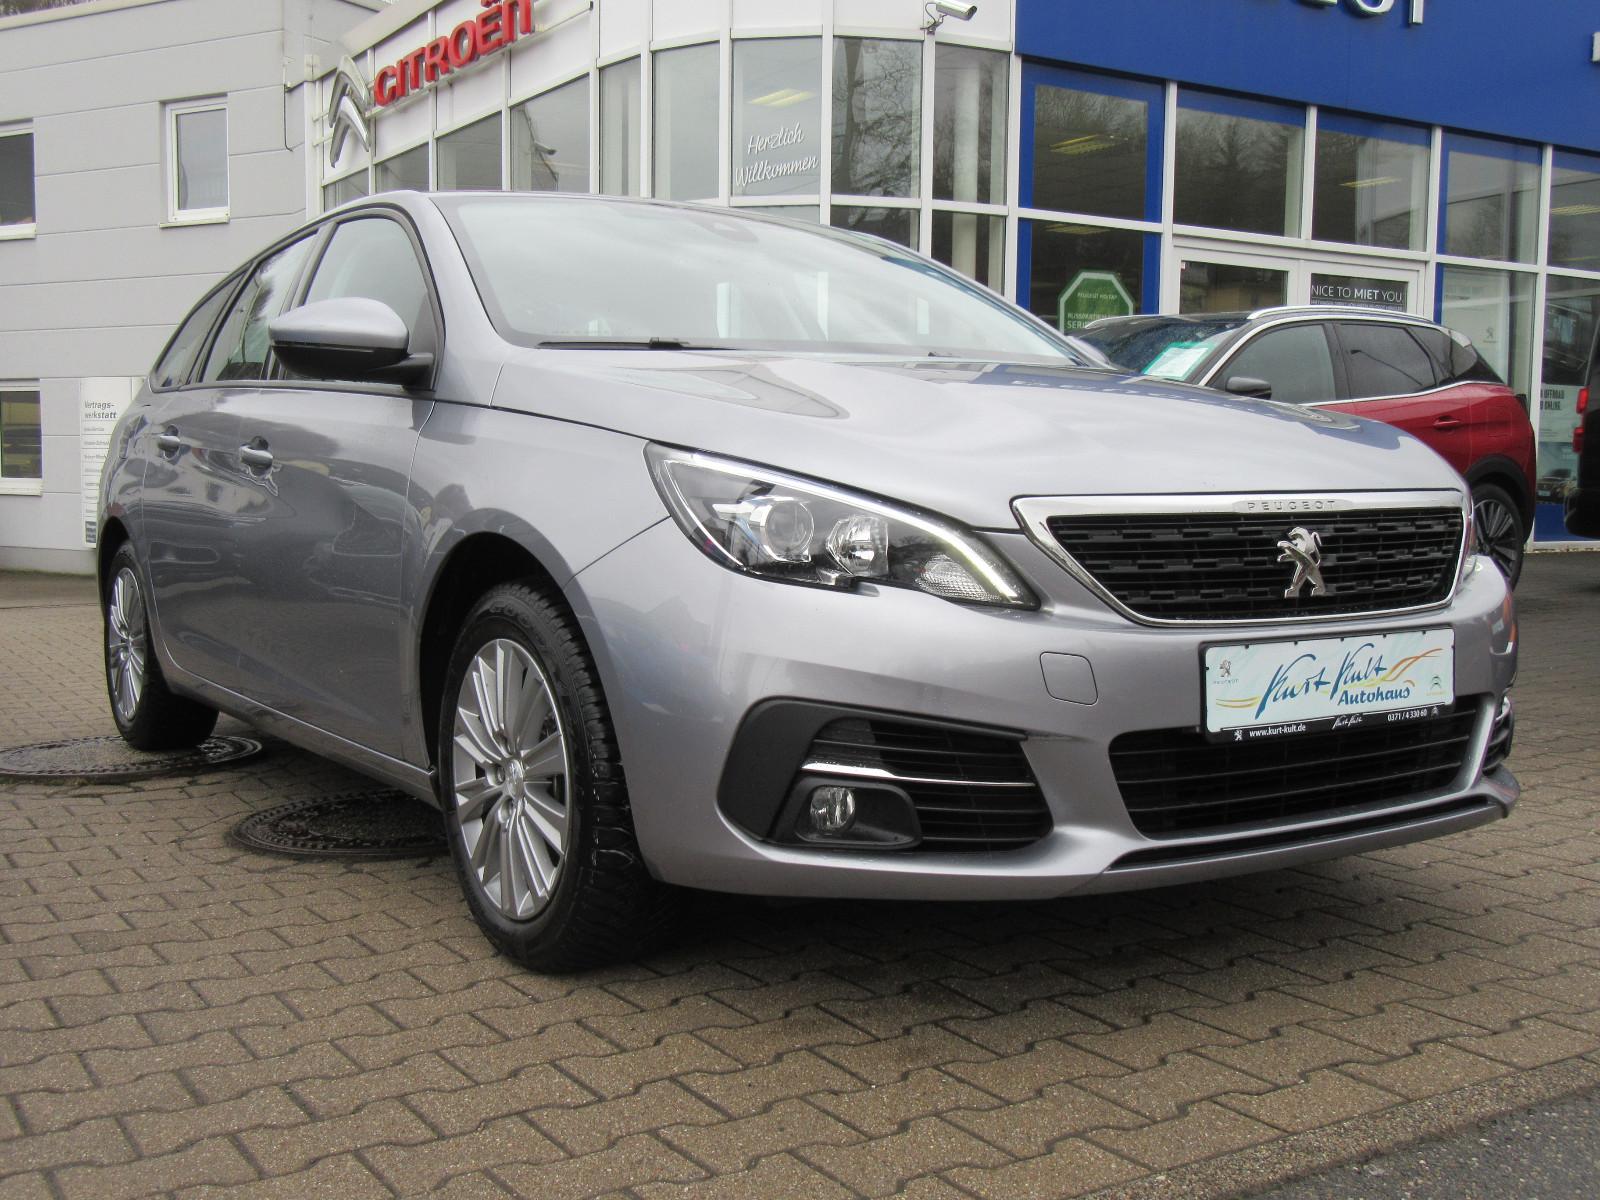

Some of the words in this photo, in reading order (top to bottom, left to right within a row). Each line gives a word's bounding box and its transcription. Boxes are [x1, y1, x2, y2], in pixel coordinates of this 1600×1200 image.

[747, 122, 804, 154] Herzlich
[735, 155, 819, 187] Willkommen
[1311, 285, 1334, 297] NICE
[1336, 286, 1351, 298] TO
[1354, 288, 1379, 300] MIET
[1381, 290, 1402, 302] YOU
[1247, 500, 1336, 512] PEUGEOT
[1255, 653, 1331, 720] Kurt
[1329, 643, 1387, 701] Kult
[1338, 686, 1411, 706] Autohaus
[1249, 718, 1306, 737] www.kurt-kult.de
